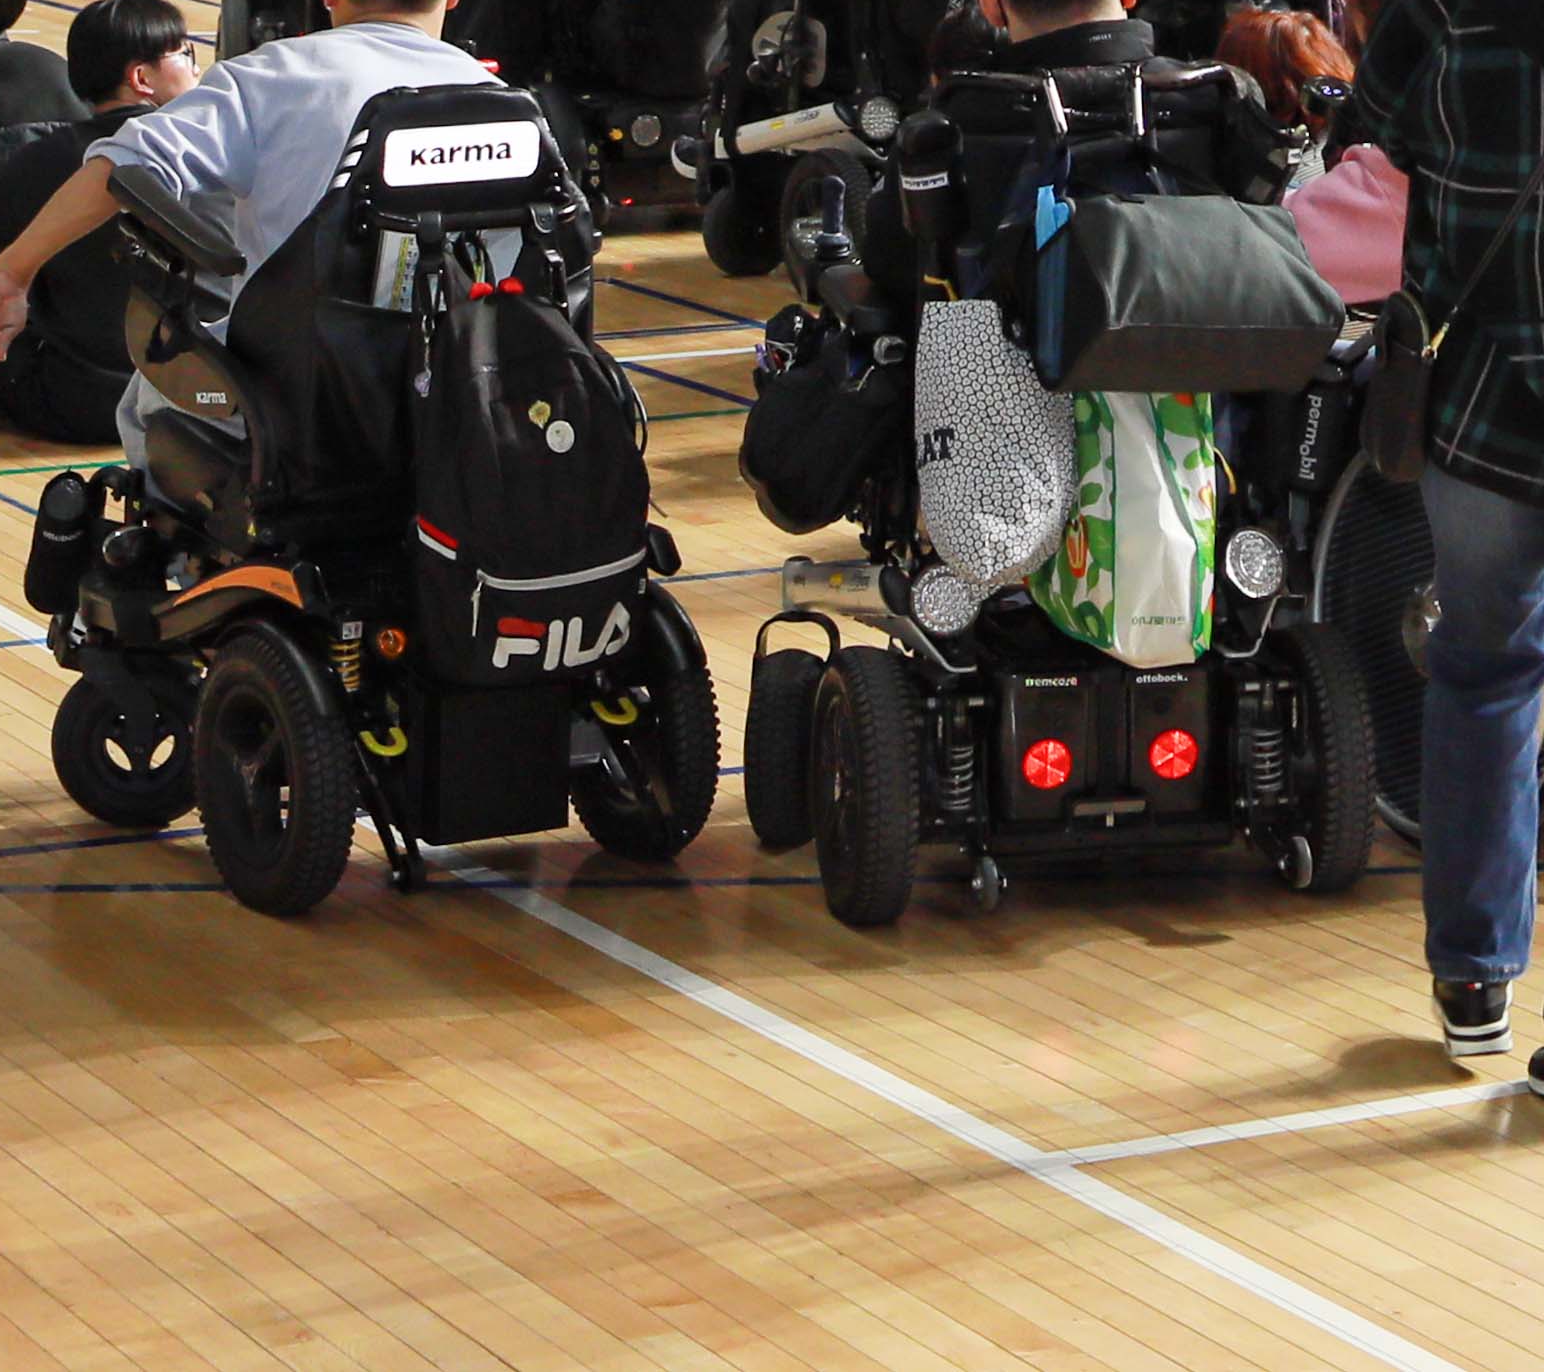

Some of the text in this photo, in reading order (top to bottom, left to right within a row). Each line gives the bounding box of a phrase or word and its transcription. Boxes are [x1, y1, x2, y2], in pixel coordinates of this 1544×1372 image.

[410, 142, 513, 167] karma
[195, 391, 227, 404] karma
[1297, 393, 1323, 481] permobil
[492, 601, 631, 671] FILA
